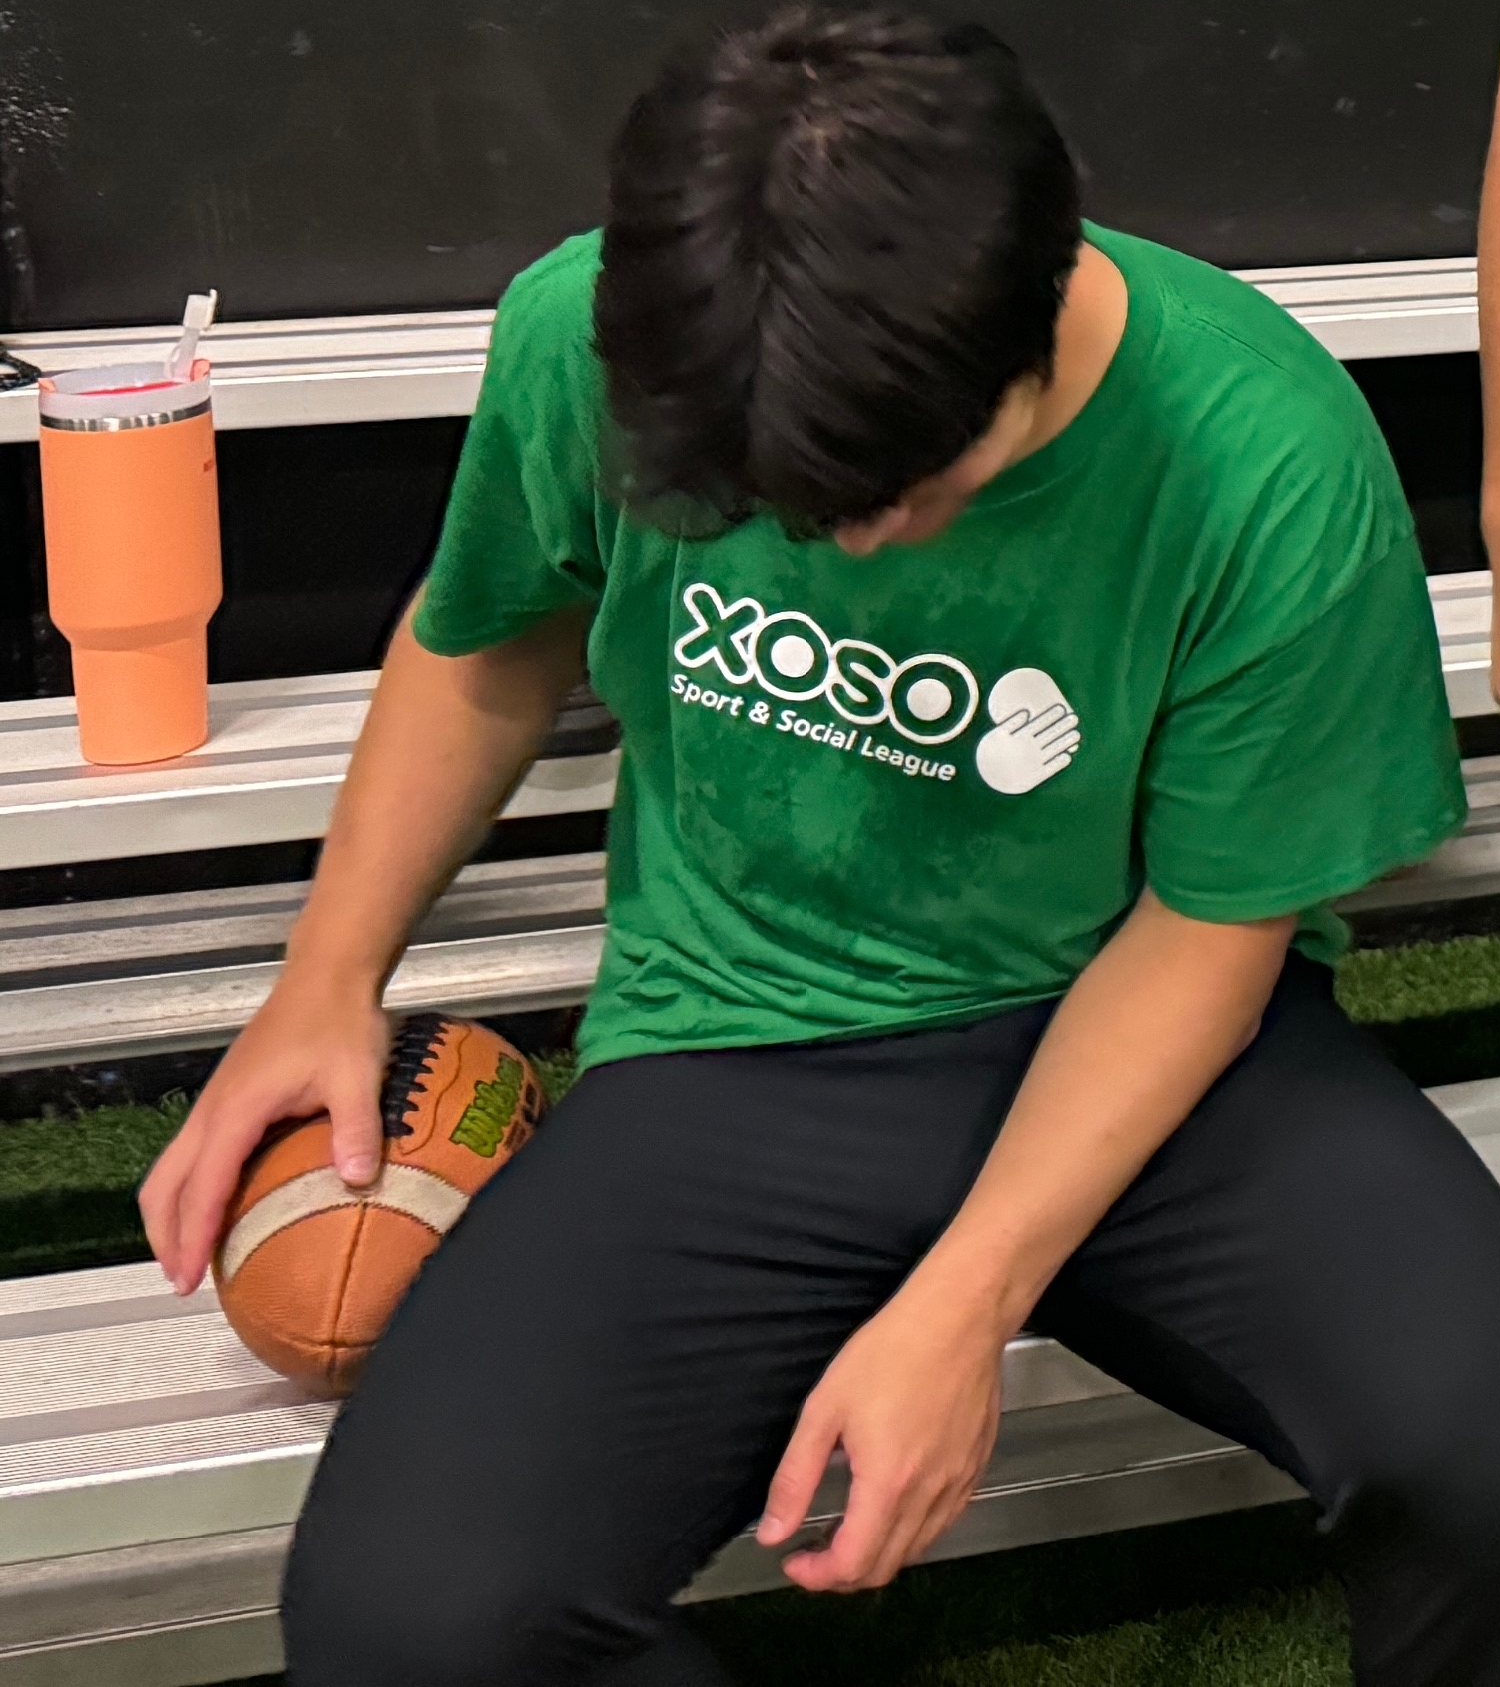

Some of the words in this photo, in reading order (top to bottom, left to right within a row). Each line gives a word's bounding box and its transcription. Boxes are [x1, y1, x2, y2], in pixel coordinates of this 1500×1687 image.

[671, 674, 744, 715] Sport
[748, 700, 770, 725] &
[775, 710, 858, 751] Social
[860, 735, 957, 782] League
[674, 582, 979, 745] XOSO
